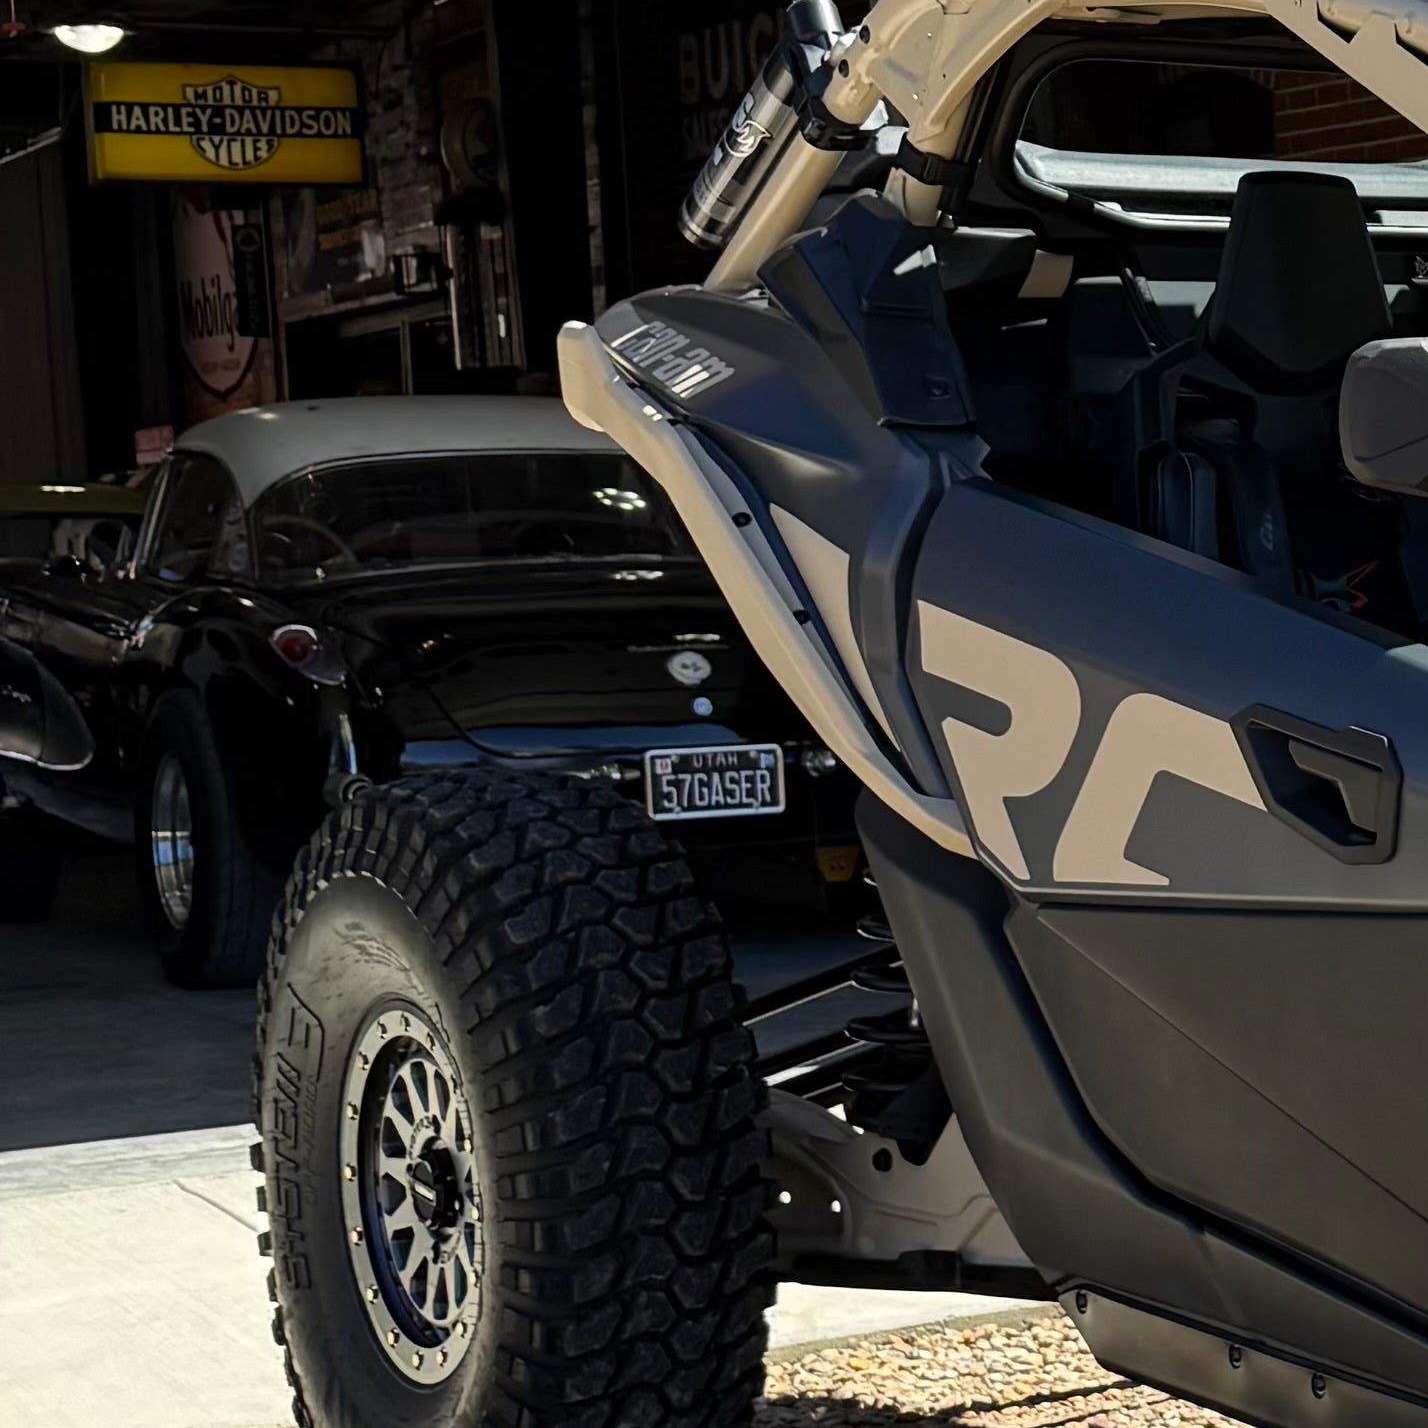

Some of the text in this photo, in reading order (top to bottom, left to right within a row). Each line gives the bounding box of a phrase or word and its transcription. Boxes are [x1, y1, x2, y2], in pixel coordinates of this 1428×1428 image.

[193, 80, 270, 105] MOTOR
[111, 103, 353, 137] HARLEY-DAVIDSON
[195, 135, 277, 168] CYCLES
[692, 752, 739, 769] UTAH
[661, 770, 772, 810] 57GASER
